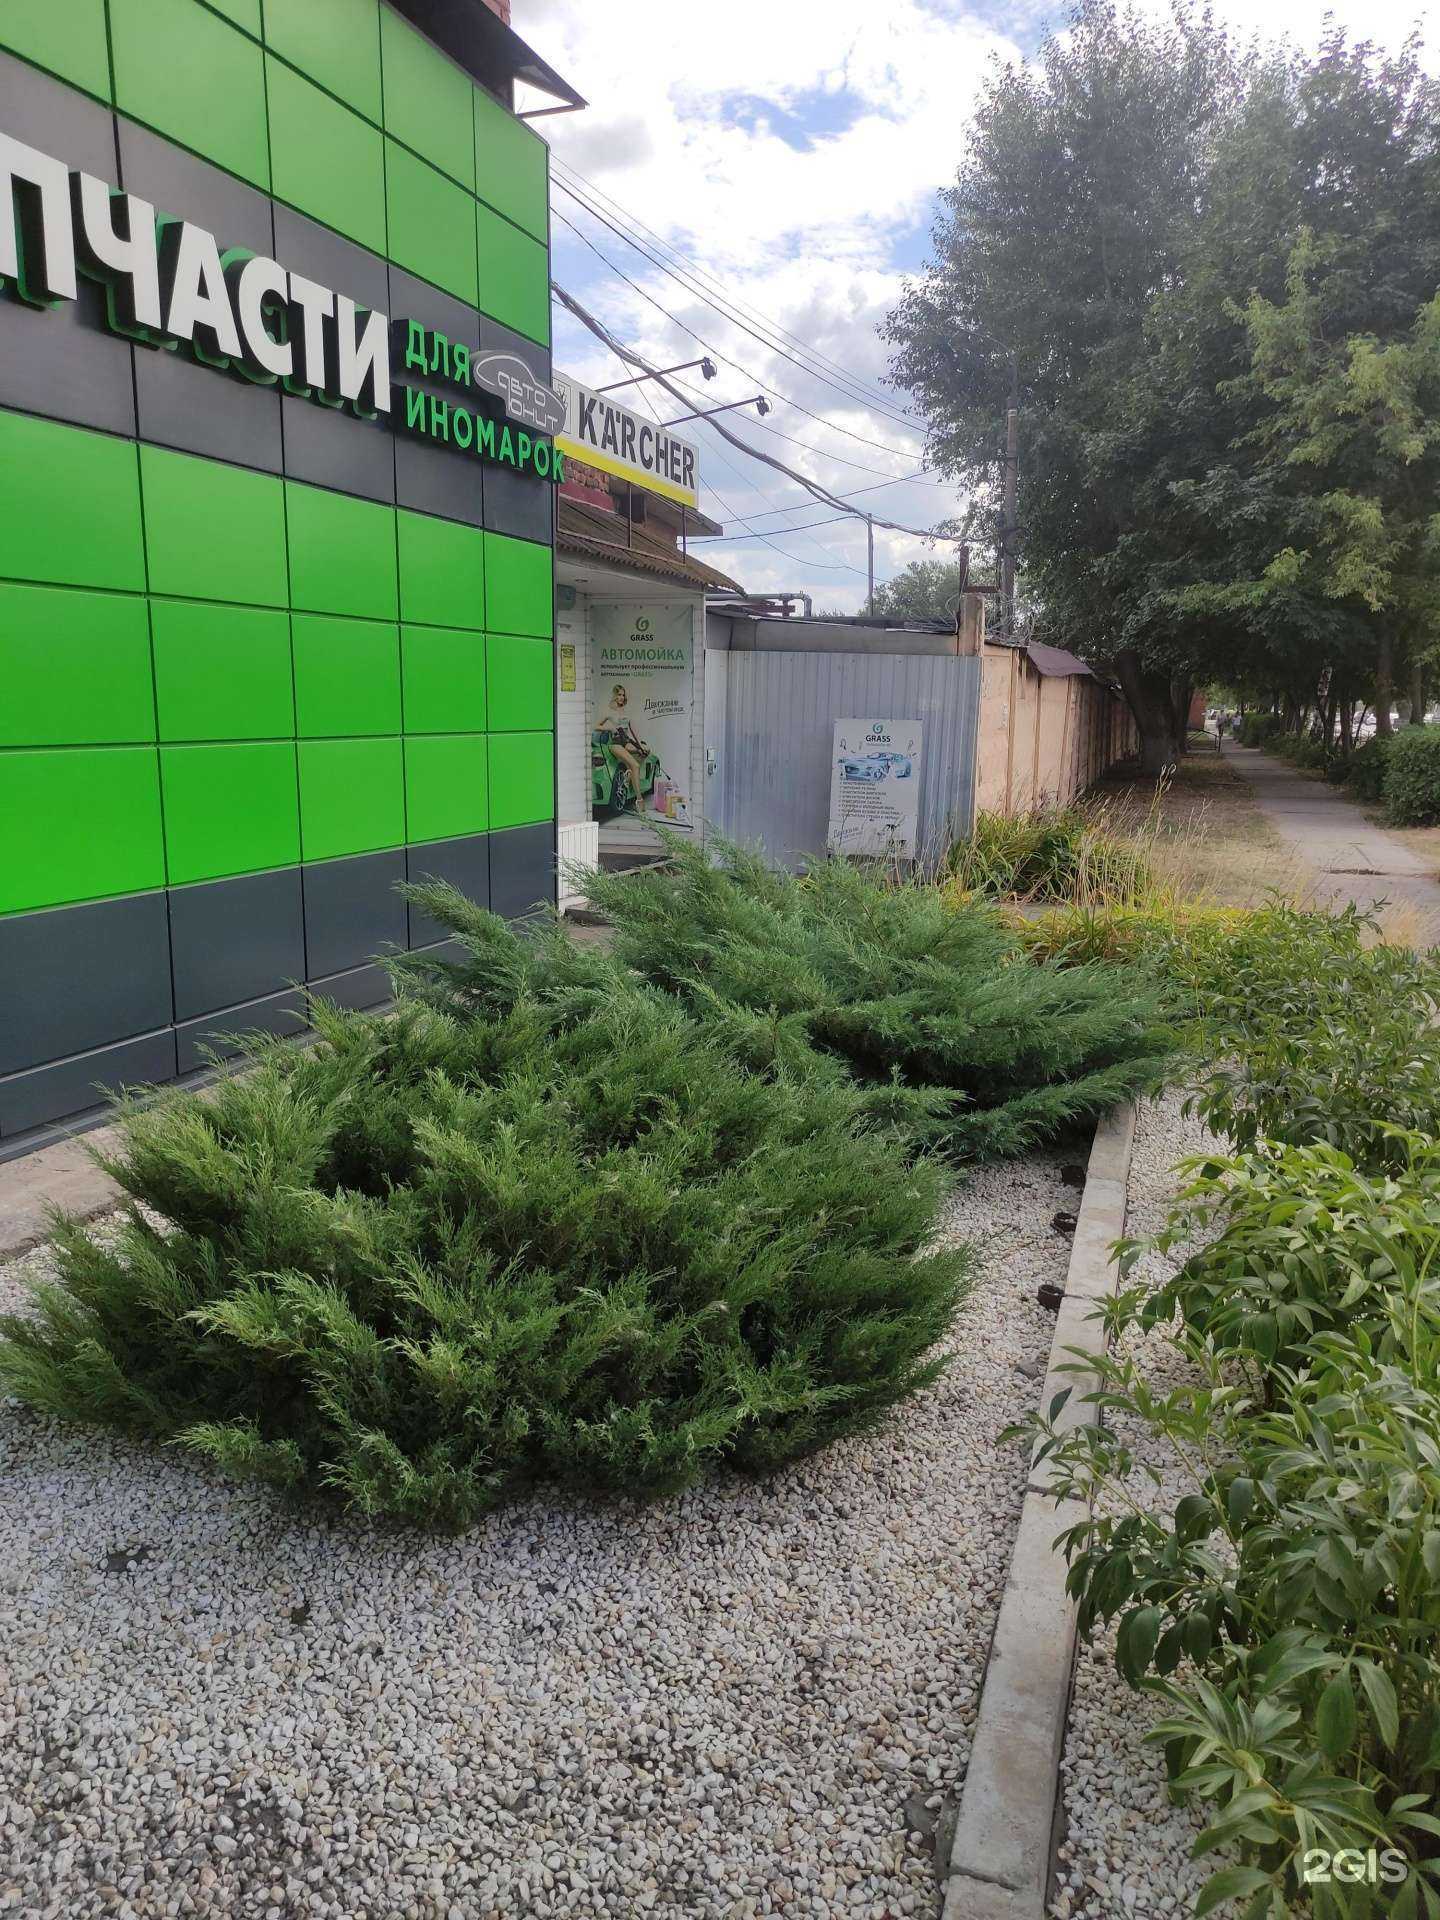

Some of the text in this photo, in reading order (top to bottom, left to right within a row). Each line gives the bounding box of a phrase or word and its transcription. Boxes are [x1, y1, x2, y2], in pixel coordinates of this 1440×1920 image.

[405, 319, 471, 387] ДЛЯ
[406, 385, 565, 483] ИНОМАРОК
[578, 391, 695, 490] KÄRCHER
[601, 647, 685, 661] АВТОМОЙКА
[630, 633, 654, 642] GRASS
[865, 734, 891, 743] GRASS
